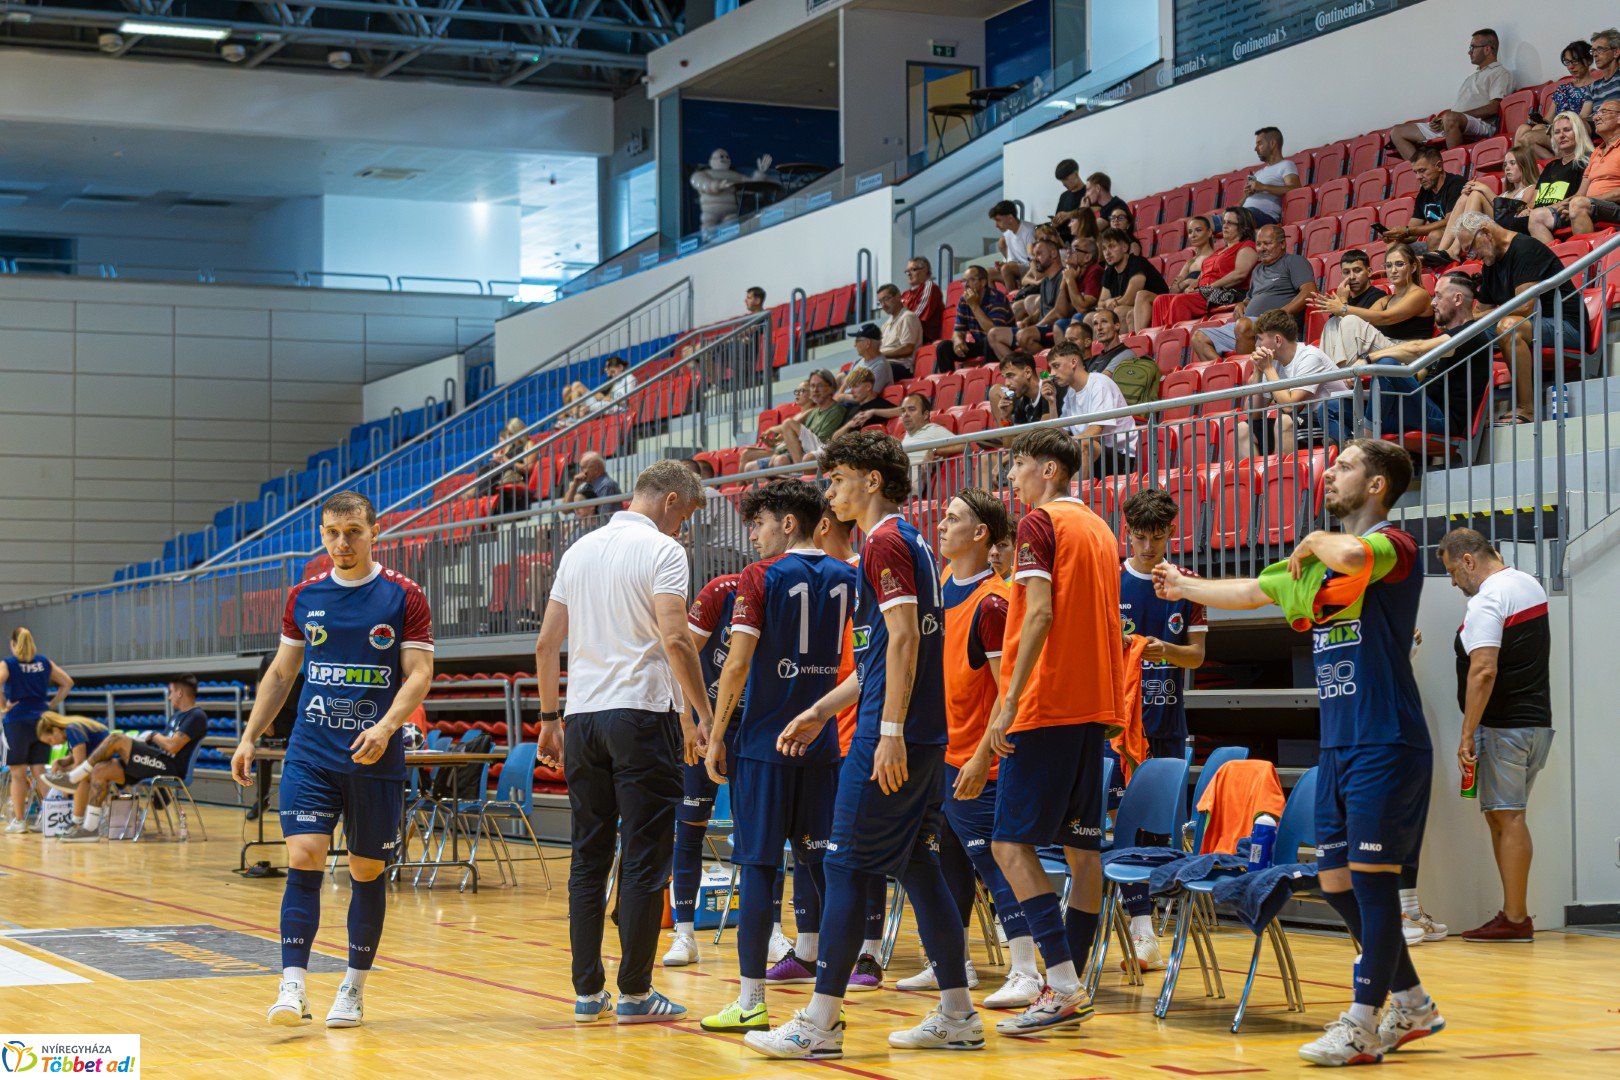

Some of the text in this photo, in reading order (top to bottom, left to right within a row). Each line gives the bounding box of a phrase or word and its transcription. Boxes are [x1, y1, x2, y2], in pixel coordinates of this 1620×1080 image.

[1315, 0, 1366, 31] Continental
[1233, 29, 1279, 60] Continental
[307, 610, 325, 618] JAKO
[789, 582, 848, 654] 11
[306, 712, 376, 730] STUDIO
[967, 839, 985, 847] JAKO
[1359, 842, 1382, 851] JAKO
